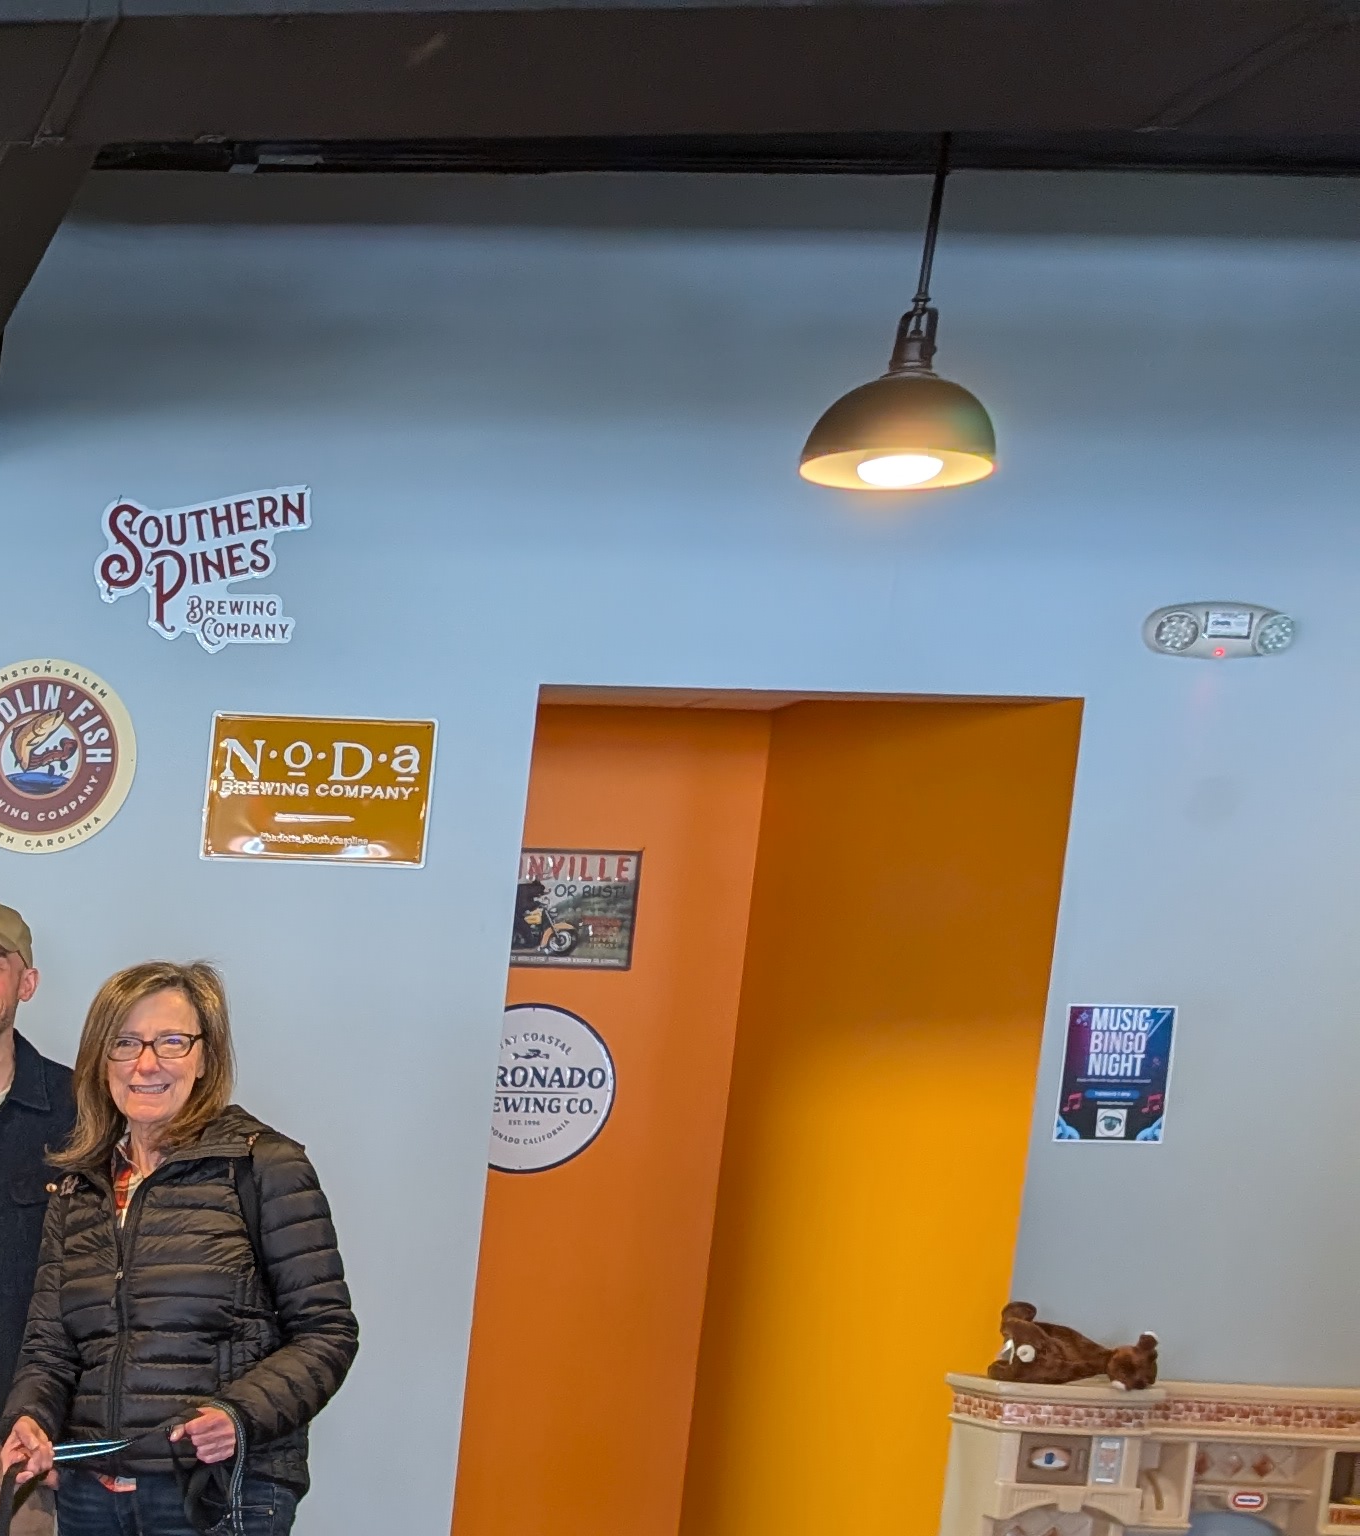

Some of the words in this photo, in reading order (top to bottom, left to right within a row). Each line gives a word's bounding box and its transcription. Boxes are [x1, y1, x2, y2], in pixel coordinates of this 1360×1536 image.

[100, 491, 307, 596] SOUTHERN
[144, 538, 272, 634] PINES
[185, 595, 278, 625] BREWING
[200, 617, 290, 646] COMPANY
[68, 699, 113, 764] FISH
[36, 774, 100, 823] COMPANY
[219, 779, 310, 798] BREWING
[314, 782, 413, 800] COMPANY
[24, 815, 103, 849] CAROLINA
[554, 884, 577, 898] OR
[582, 884, 627, 898] BUST!
[1090, 1007, 1152, 1031] MUSIC
[523, 1032, 572, 1056] COASTAL
[1089, 1030, 1148, 1054] BINGO
[1087, 1053, 1146, 1077] NIGHT
[493, 1096, 561, 1114] EWING
[566, 1097, 598, 1115] CO.
[523, 1119, 570, 1145] CALIFORNIA
